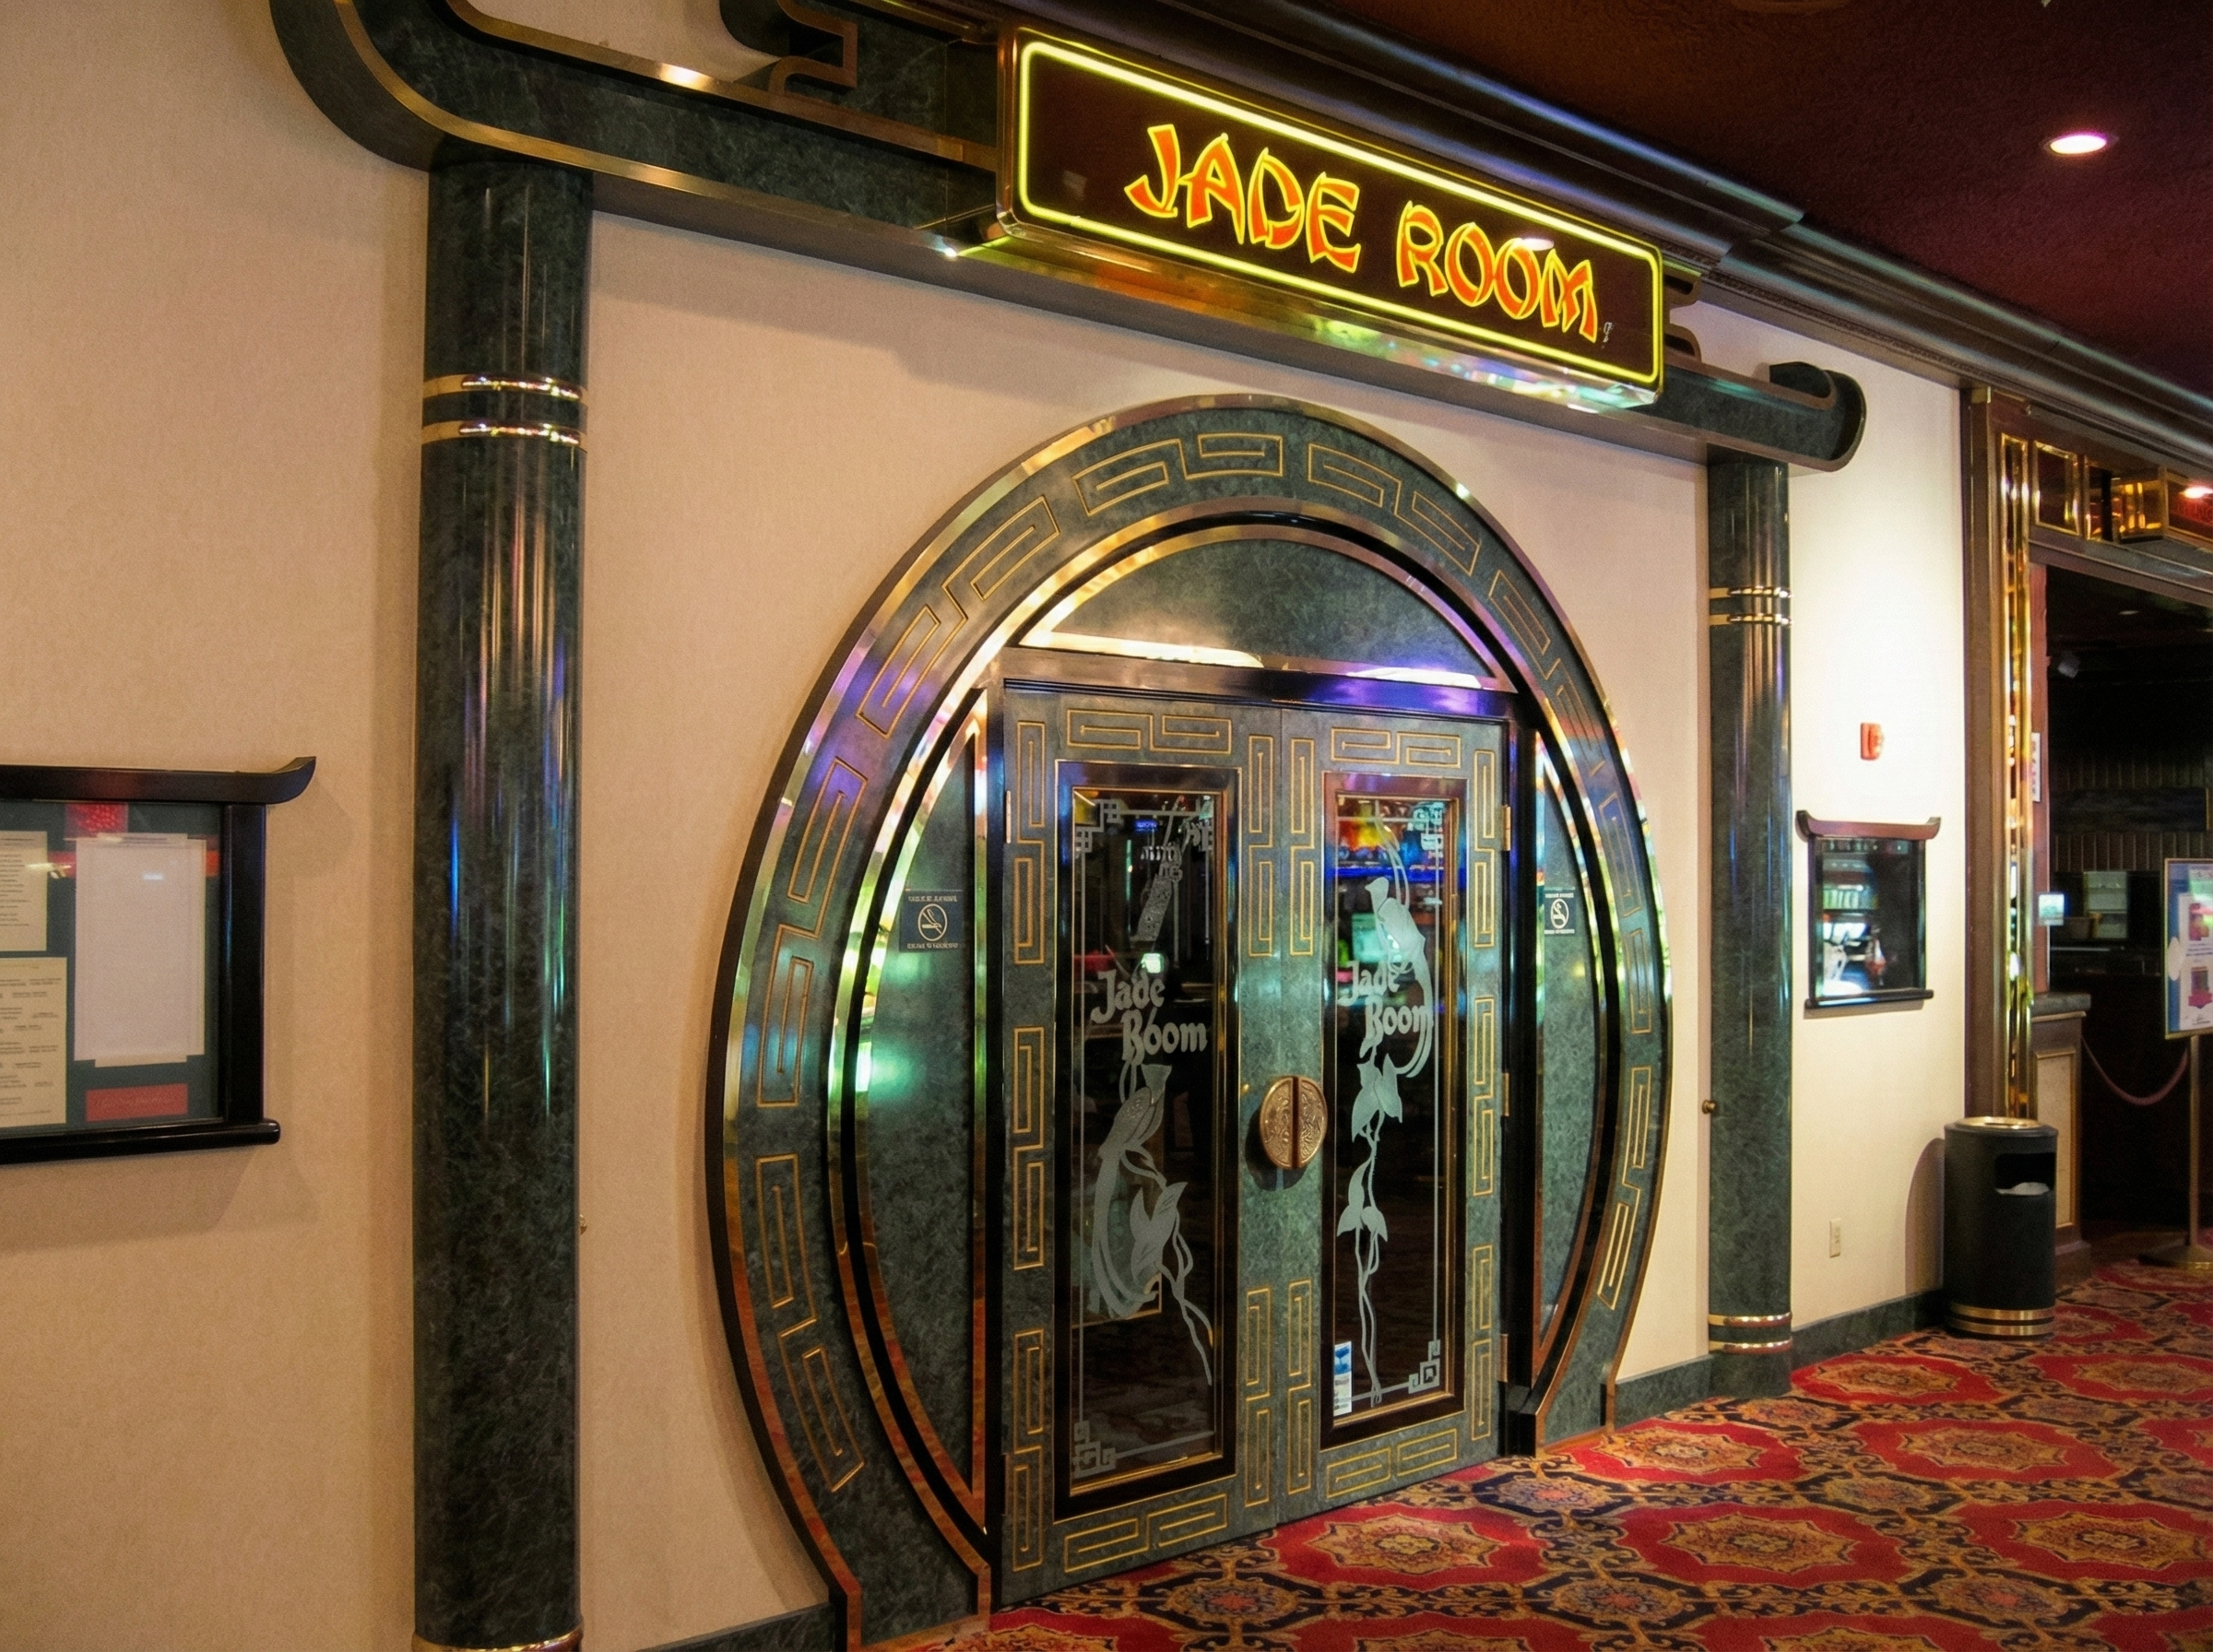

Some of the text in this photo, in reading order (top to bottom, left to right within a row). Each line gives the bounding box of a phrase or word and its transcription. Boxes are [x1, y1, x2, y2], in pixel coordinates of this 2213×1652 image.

[1124, 124, 1599, 344] JADE ROOM
[1090, 969, 1166, 1024] Jade
[1336, 960, 1401, 1007] Jade
[1120, 1009, 1208, 1067] Room
[1363, 995, 1434, 1047] Room
